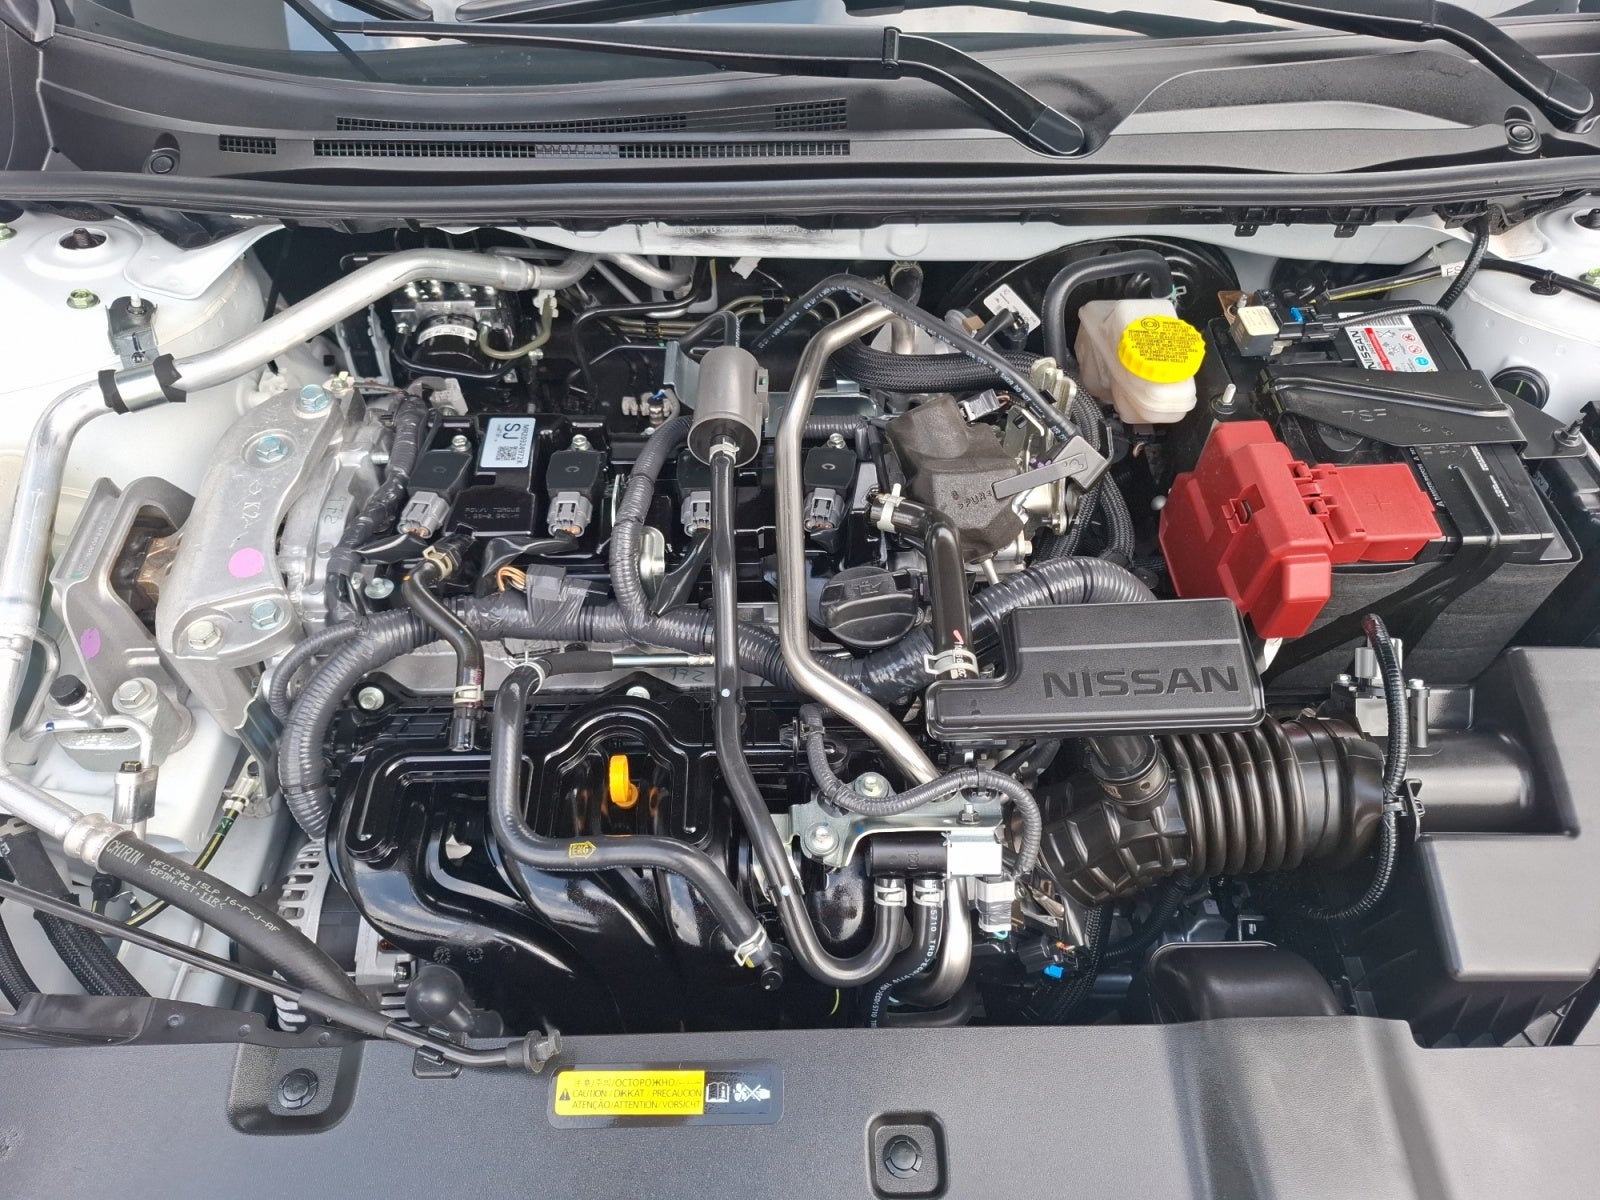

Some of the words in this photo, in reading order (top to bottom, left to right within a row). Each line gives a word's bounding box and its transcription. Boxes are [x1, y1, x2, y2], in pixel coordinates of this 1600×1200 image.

[1349, 330, 1378, 370] NISSAN
[503, 423, 521, 439] SJ
[1042, 665, 1240, 699] NISSAN
[106, 840, 145, 866] CHIRIN
